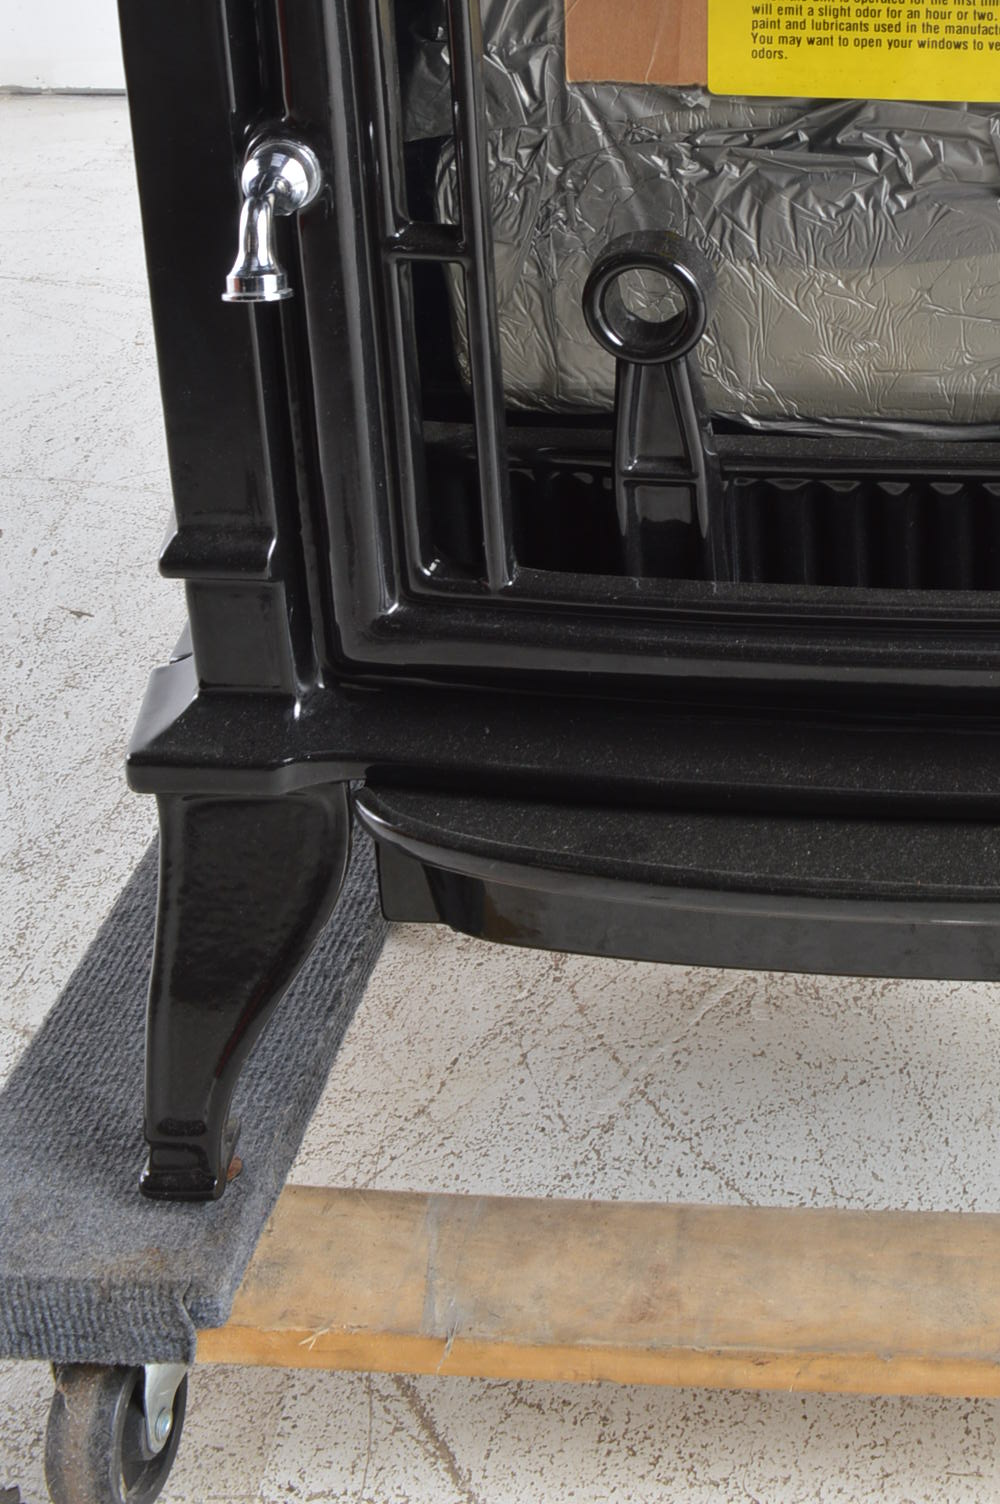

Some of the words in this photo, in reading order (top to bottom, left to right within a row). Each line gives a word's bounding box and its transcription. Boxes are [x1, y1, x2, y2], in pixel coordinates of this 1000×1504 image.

[752, 3, 772, 15] will
[777, 4, 803, 16] emit
[807, 6, 814, 17] a
[818, 5, 851, 19] slight
[855, 6, 882, 18] odor
[886, 6, 902, 19] for
[906, 9, 920, 19] an
[925, 8, 952, 20] hour
[956, 11, 968, 21] or
[973, 9, 997, 21] two.
[752, 18, 781, 31] paint
[785, 19, 806, 30] and
[811, 19, 869, 32] lubricants
[874, 21, 901, 33] used
[906, 22, 917, 33] in
[922, 22, 940, 34] the
[751, 32, 773, 45] You
[778, 35, 802, 47] may
[806, 35, 834, 46] want
[838, 35, 849, 47] to
[853, 37, 882, 49] open
[887, 39, 913, 50] your
[917, 38, 968, 50] windows
[973, 39, 984, 51] to
[751, 47, 787, 59] odors.
